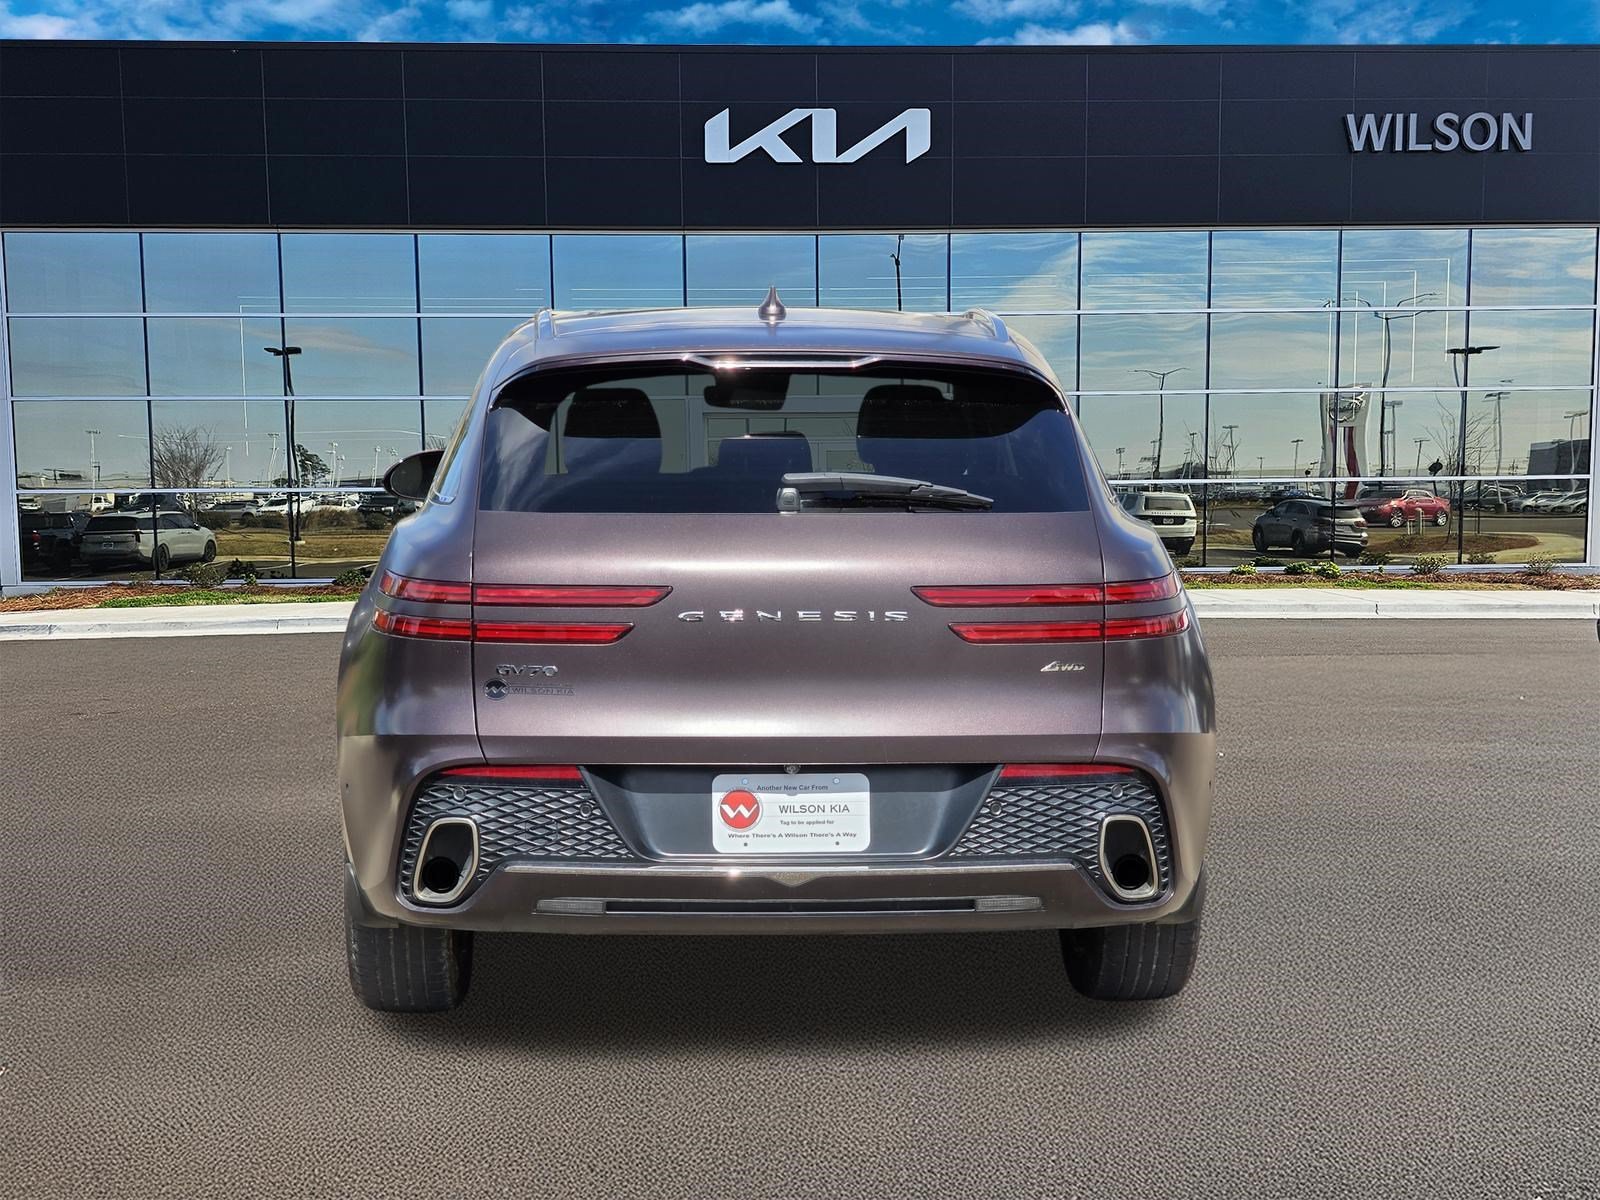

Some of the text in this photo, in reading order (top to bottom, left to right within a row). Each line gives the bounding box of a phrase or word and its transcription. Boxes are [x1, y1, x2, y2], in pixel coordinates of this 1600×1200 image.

[705, 107, 931, 164] KIA
[1345, 111, 1534, 152] WILSON
[677, 609, 909, 622] GENESIS
[495, 664, 559, 677] GV70
[511, 687, 554, 696] WILSON
[778, 804, 850, 814] WILSON KIA
